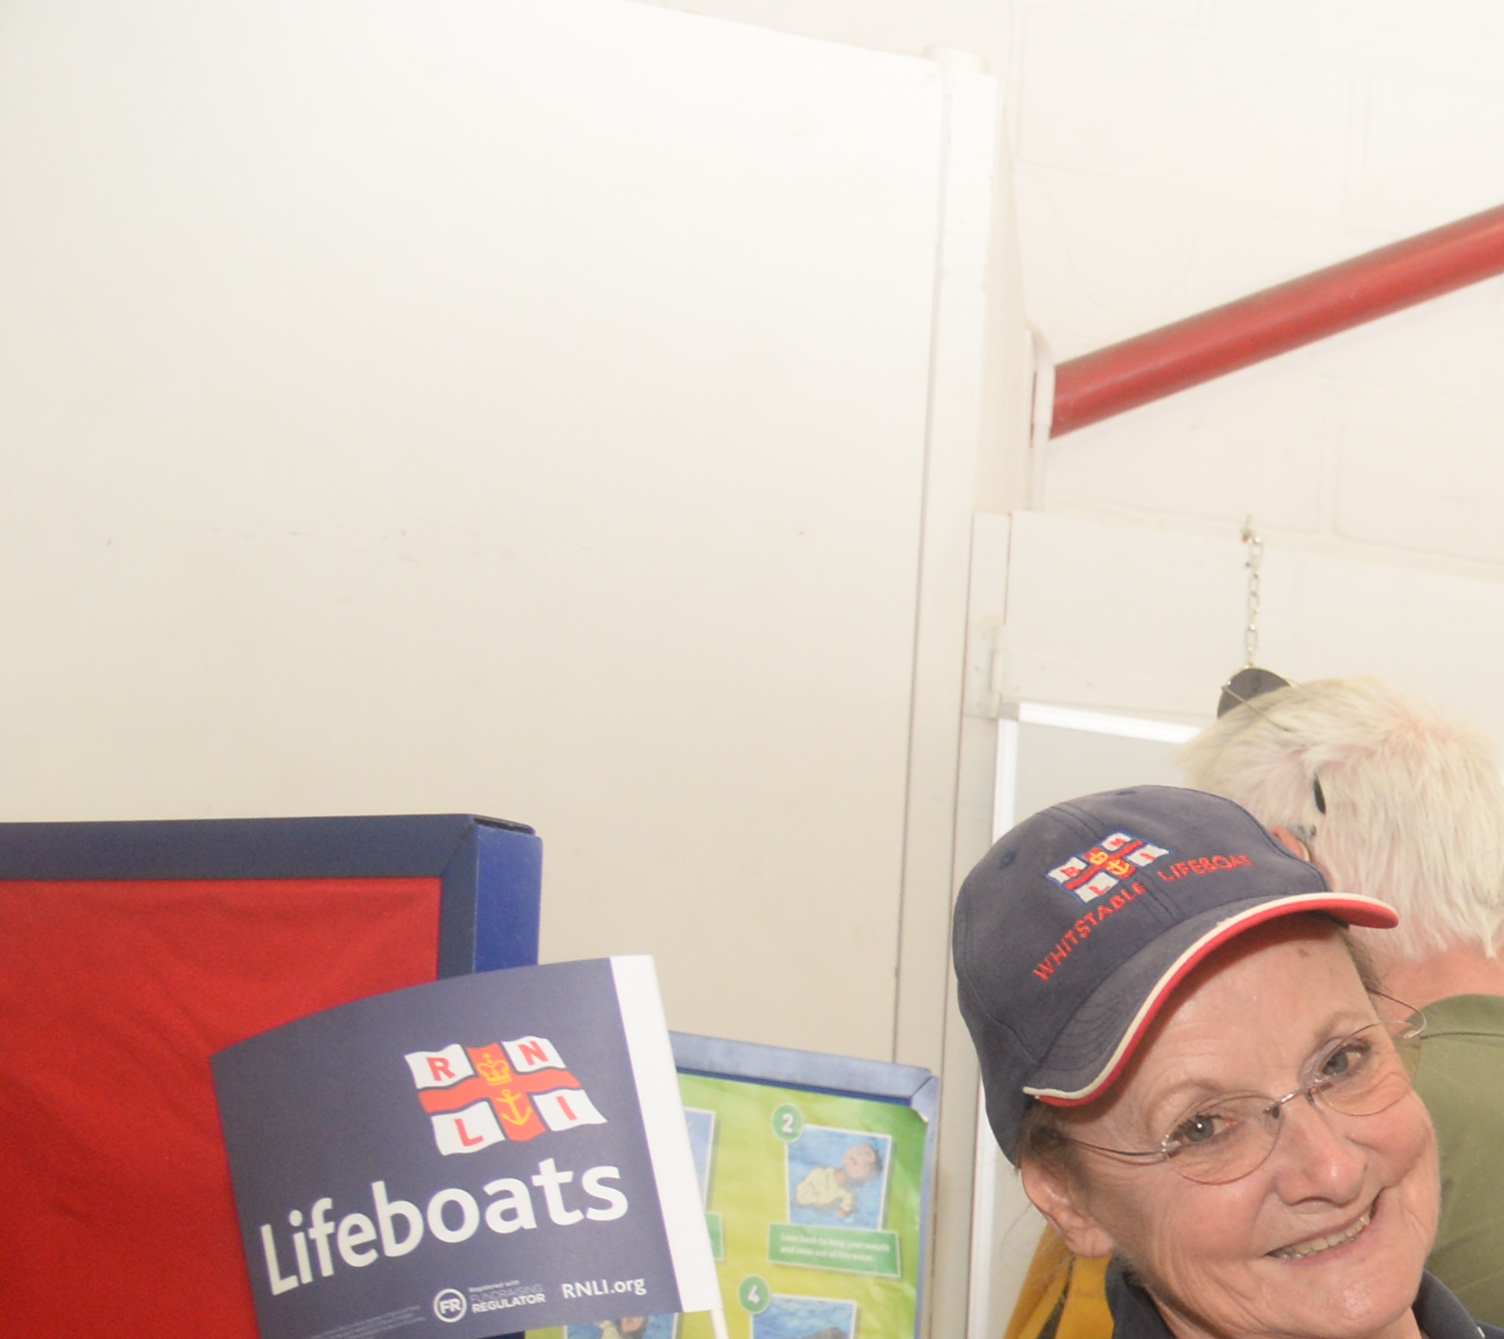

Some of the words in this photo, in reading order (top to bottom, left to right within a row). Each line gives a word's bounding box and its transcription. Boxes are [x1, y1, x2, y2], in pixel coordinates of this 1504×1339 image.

[1033, 881, 1147, 982] WHITSTABLE
[1157, 853, 1254, 883] LIFEBOAT
[782, 1113, 793, 1133] 2
[260, 1157, 629, 1296] Lifeboats
[561, 1277, 647, 1299] RNLI.org
[748, 1285, 760, 1304] 4
[471, 1293, 546, 1313] REGULATOR
